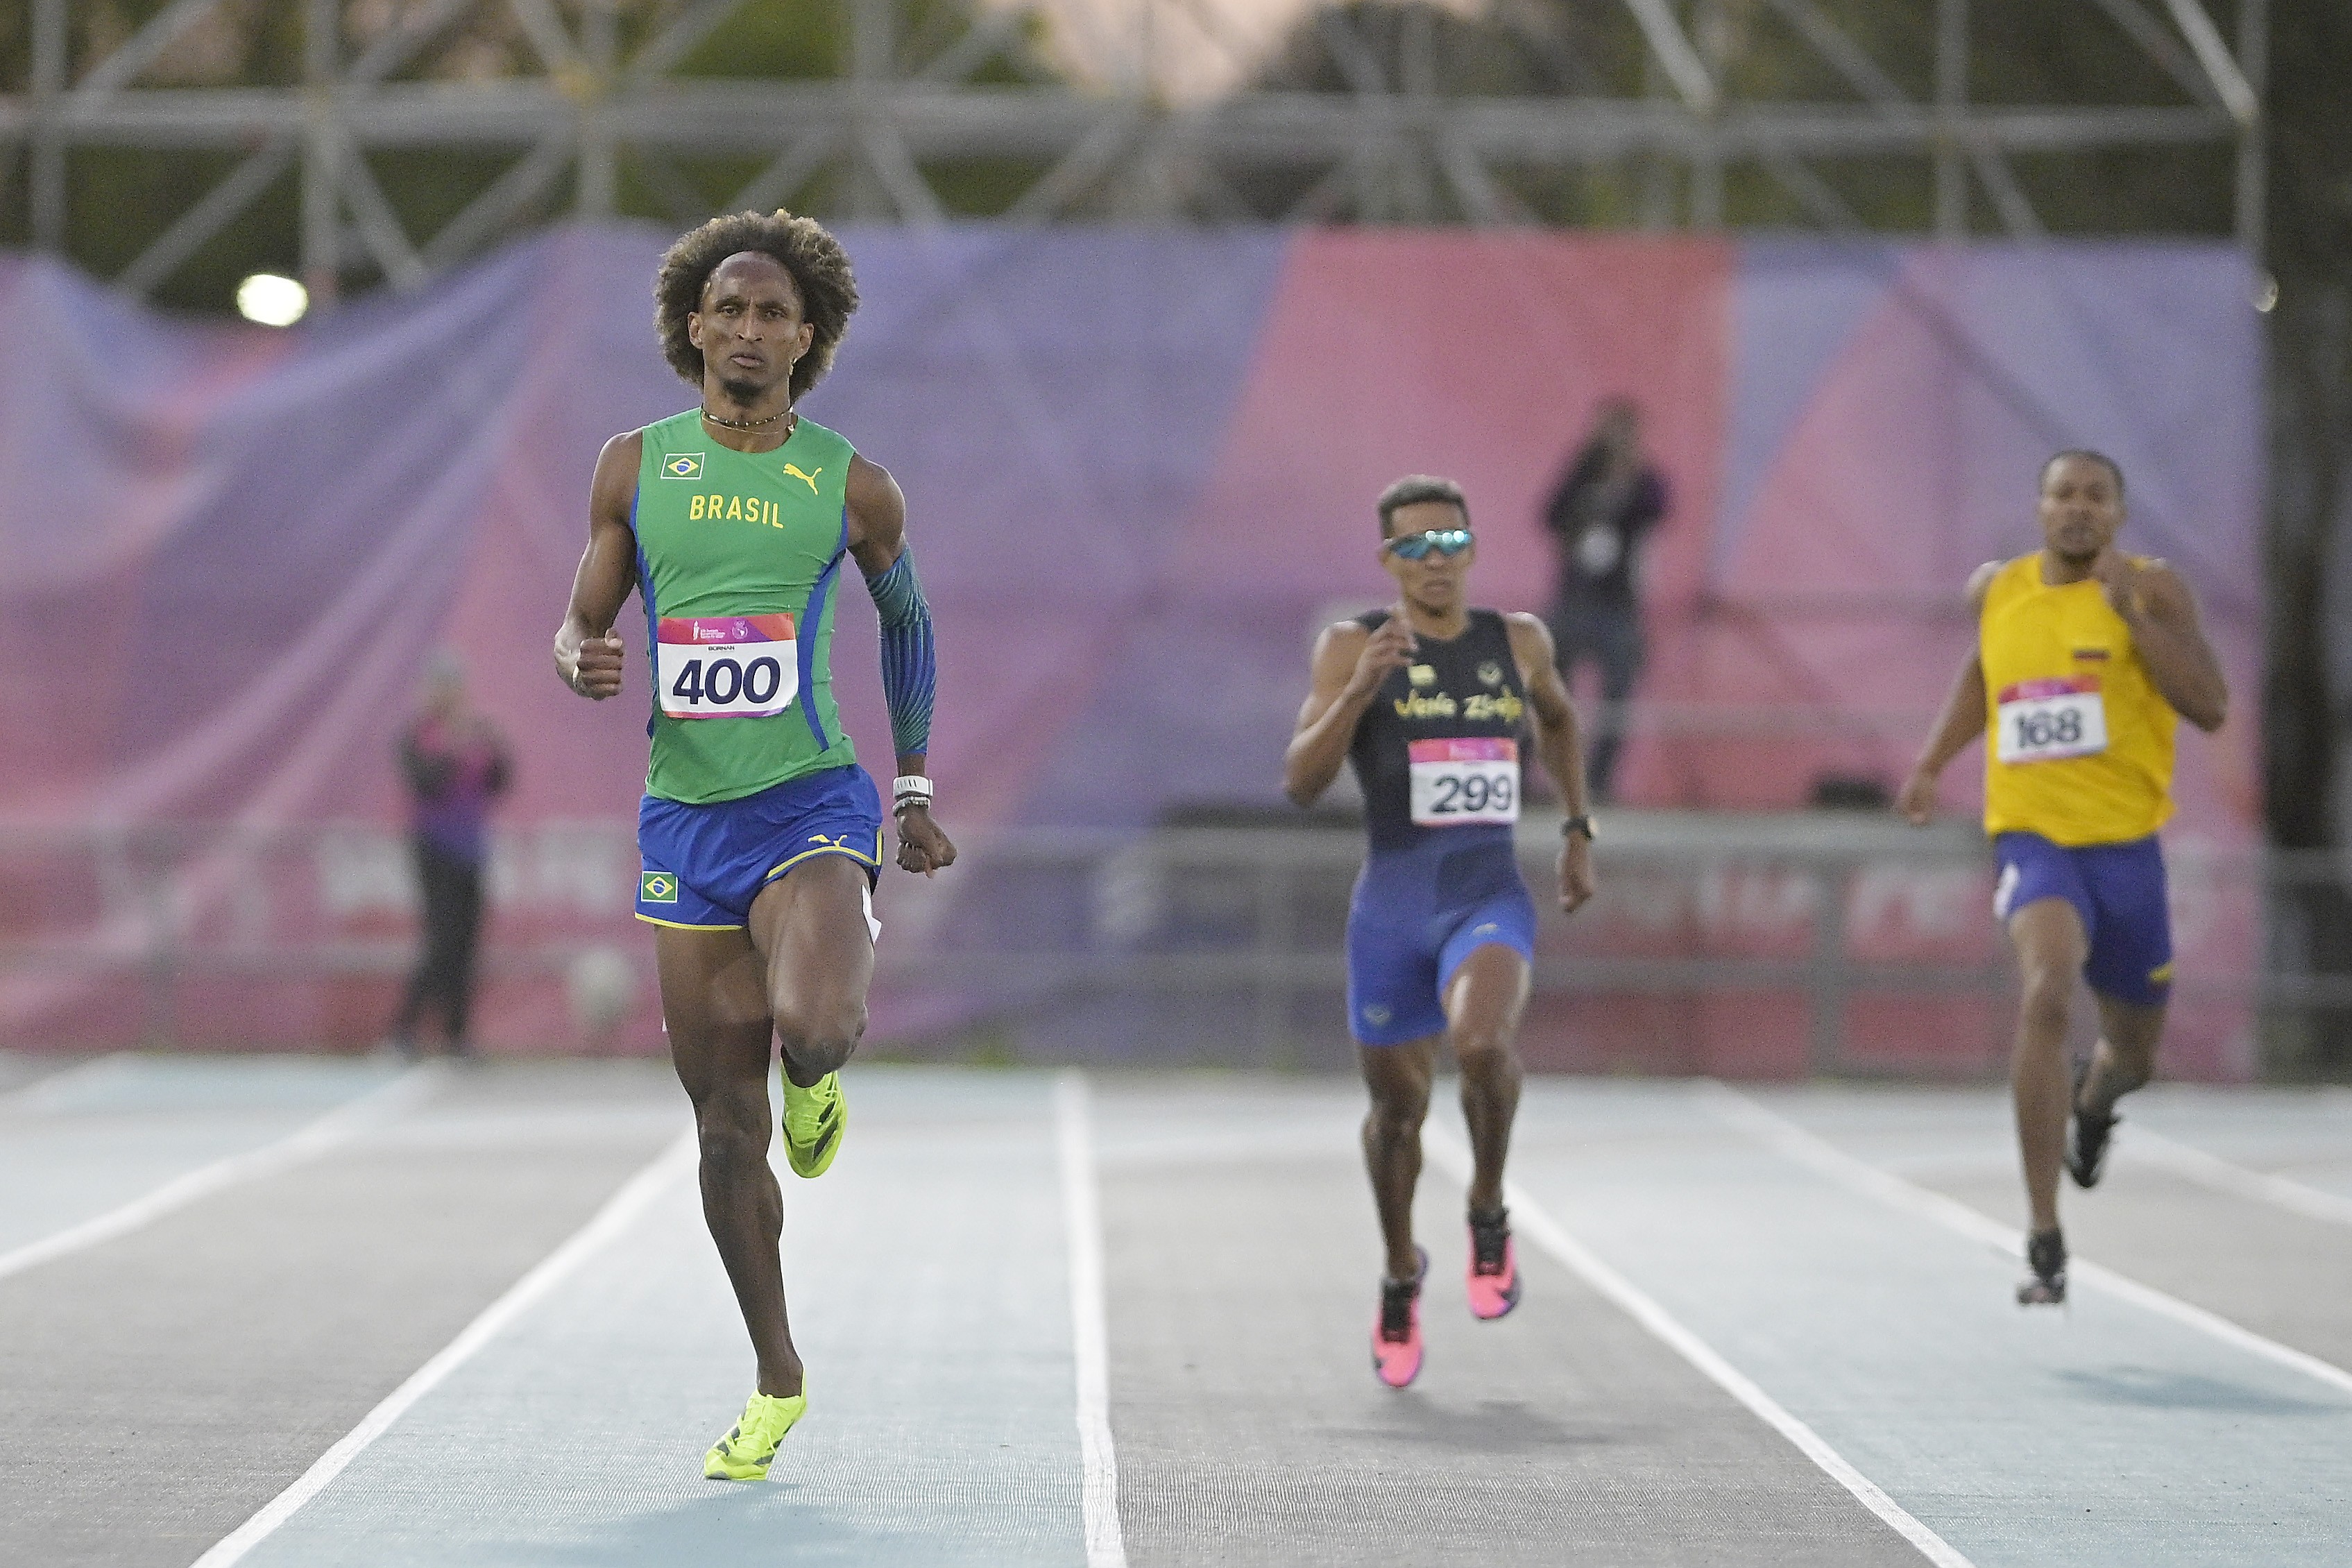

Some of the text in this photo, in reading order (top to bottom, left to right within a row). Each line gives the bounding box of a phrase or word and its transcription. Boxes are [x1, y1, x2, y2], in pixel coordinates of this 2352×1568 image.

[690, 494, 784, 529] BRASIL
[673, 656, 781, 705] 400
[2015, 706, 2081, 749] 168
[1431, 772, 1512, 813] 299
